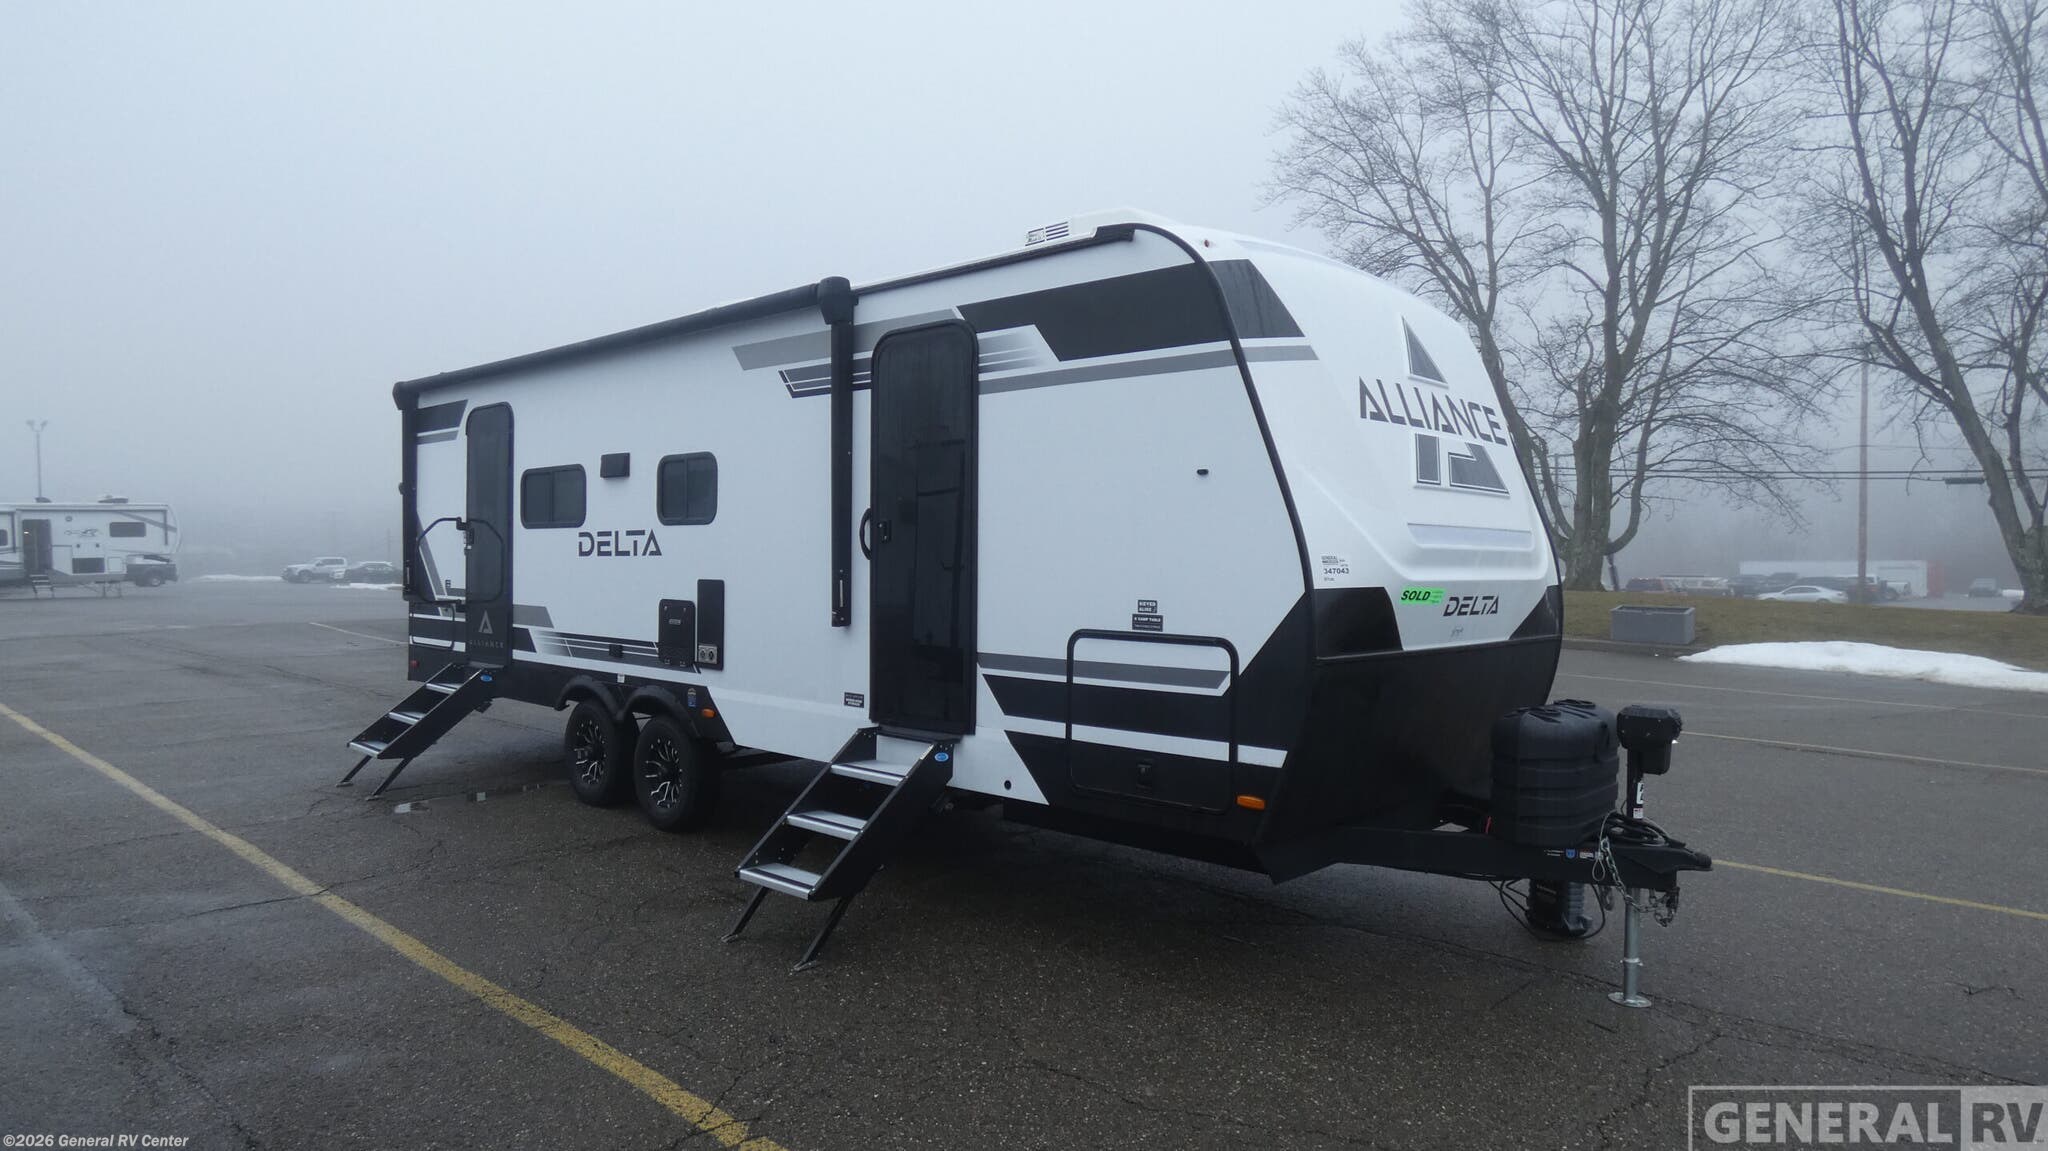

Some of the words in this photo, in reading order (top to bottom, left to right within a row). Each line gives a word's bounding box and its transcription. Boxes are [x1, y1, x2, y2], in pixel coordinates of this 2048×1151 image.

[1359, 376, 1508, 447] ALLIANCE
[578, 529, 662, 557] DELTA
[1400, 590, 1432, 601] SOLD
[1442, 595, 1499, 617] DELTA
